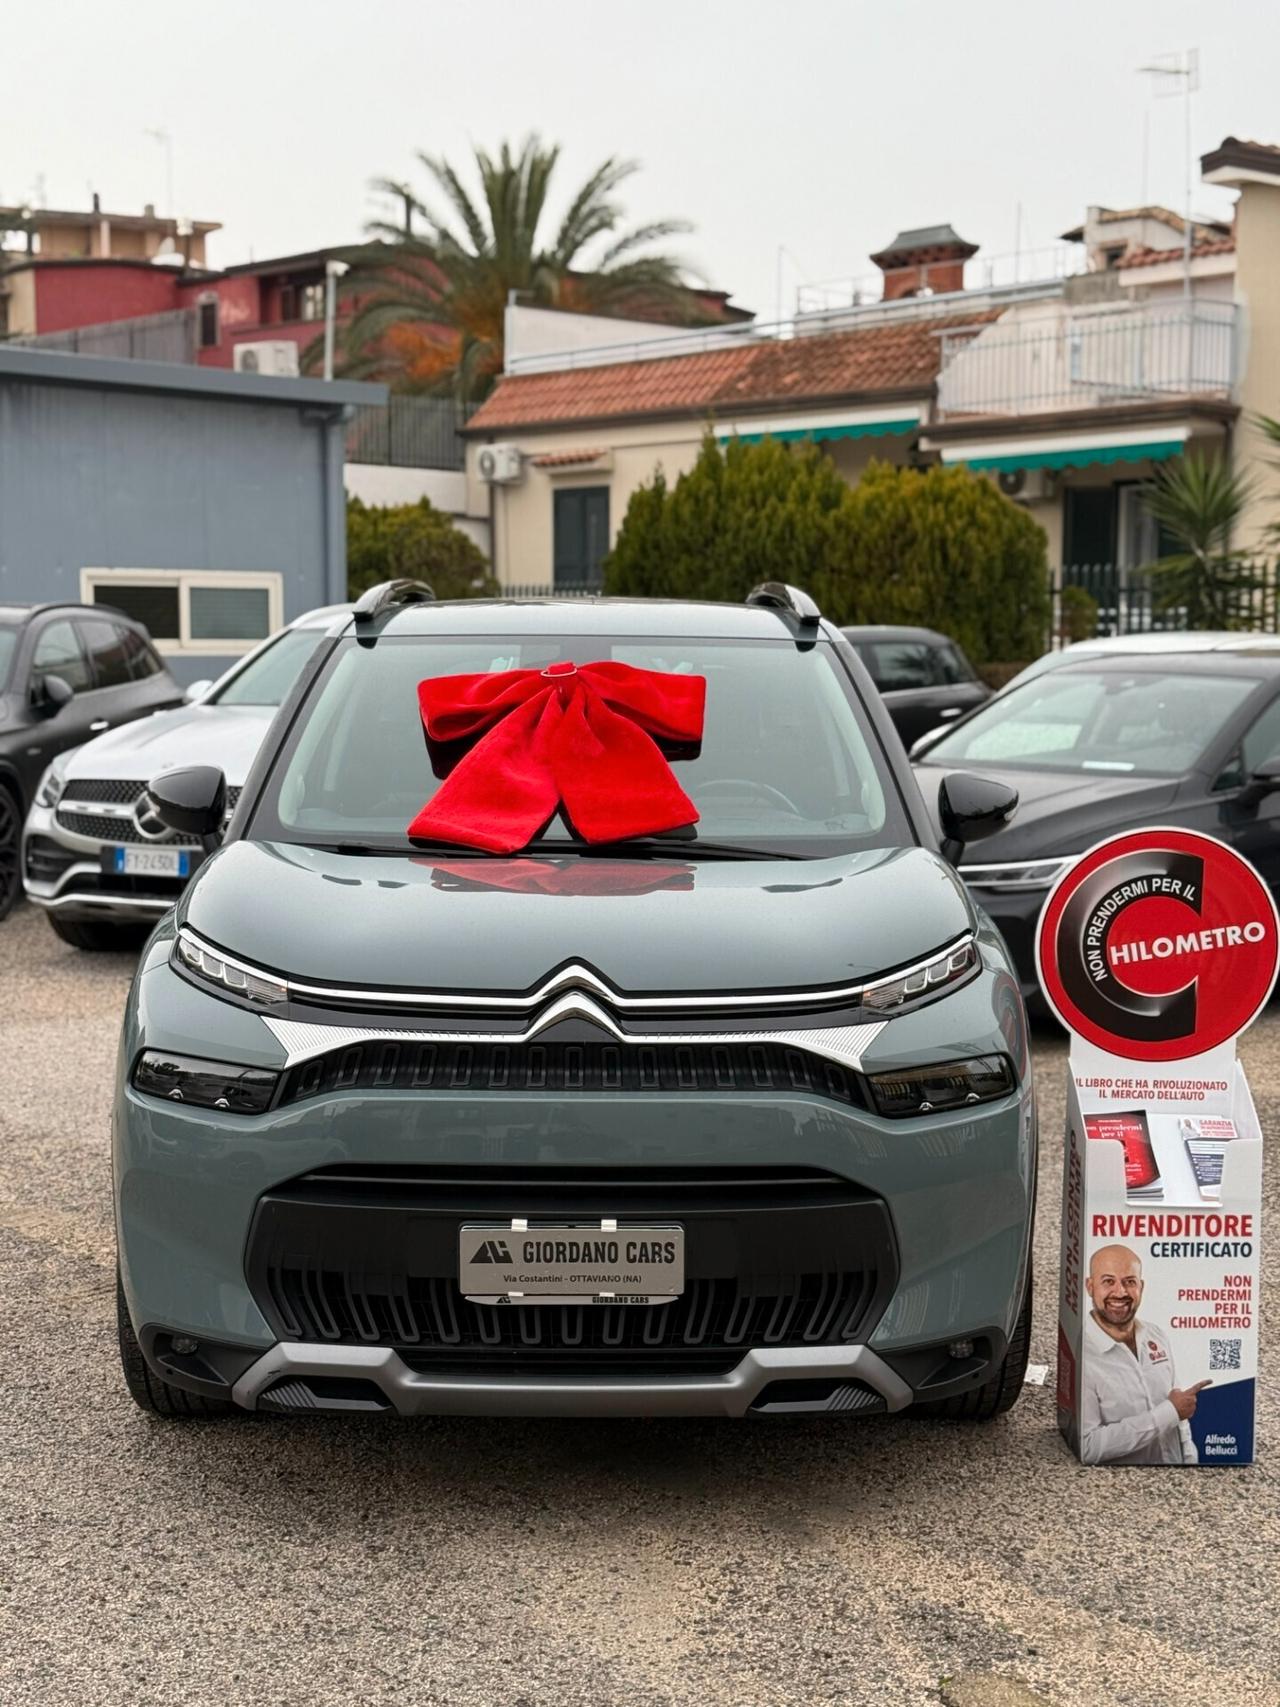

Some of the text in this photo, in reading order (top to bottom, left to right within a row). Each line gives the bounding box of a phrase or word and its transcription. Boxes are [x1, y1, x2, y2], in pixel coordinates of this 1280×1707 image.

[1087, 878, 1197, 982] NON PRENDERMI PER IL
[1085, 1078, 1113, 1088] LIBRO
[1115, 1078, 1134, 1089] CHE
[1135, 1079, 1149, 1089] HA
[1152, 1080, 1228, 1091] RIVOLUZIONATO
[1099, 1089, 1205, 1101] IL MERCATO DELL'AUTO
[1067, 1129, 1077, 1239] CONTRO
[1072, 1149, 1082, 1265] INSIEME
[1092, 1214, 1253, 1238] RIVENDITORE
[522, 1241, 619, 1264] GIORDANO
[626, 1241, 676, 1264] CARS
[1150, 1241, 1253, 1258] CERTIFICATO
[503, 1274, 518, 1283] Via
[518, 1274, 563, 1283] Costantini
[569, 1274, 621, 1283] OTTAVIANO
[622, 1274, 642, 1284] (NA)
[1224, 1275, 1252, 1288] NON
[592, 1296, 628, 1304] GIORDANO
[630, 1296, 649, 1304] CARS
[1178, 1289, 1251, 1301] PRENDERMI
[1214, 1303, 1252, 1315] PER IL
[1170, 1316, 1251, 1329] CHILOMETRO
[1205, 1434, 1236, 1444] Alfredo
[1205, 1446, 1238, 1455] Bellucci
